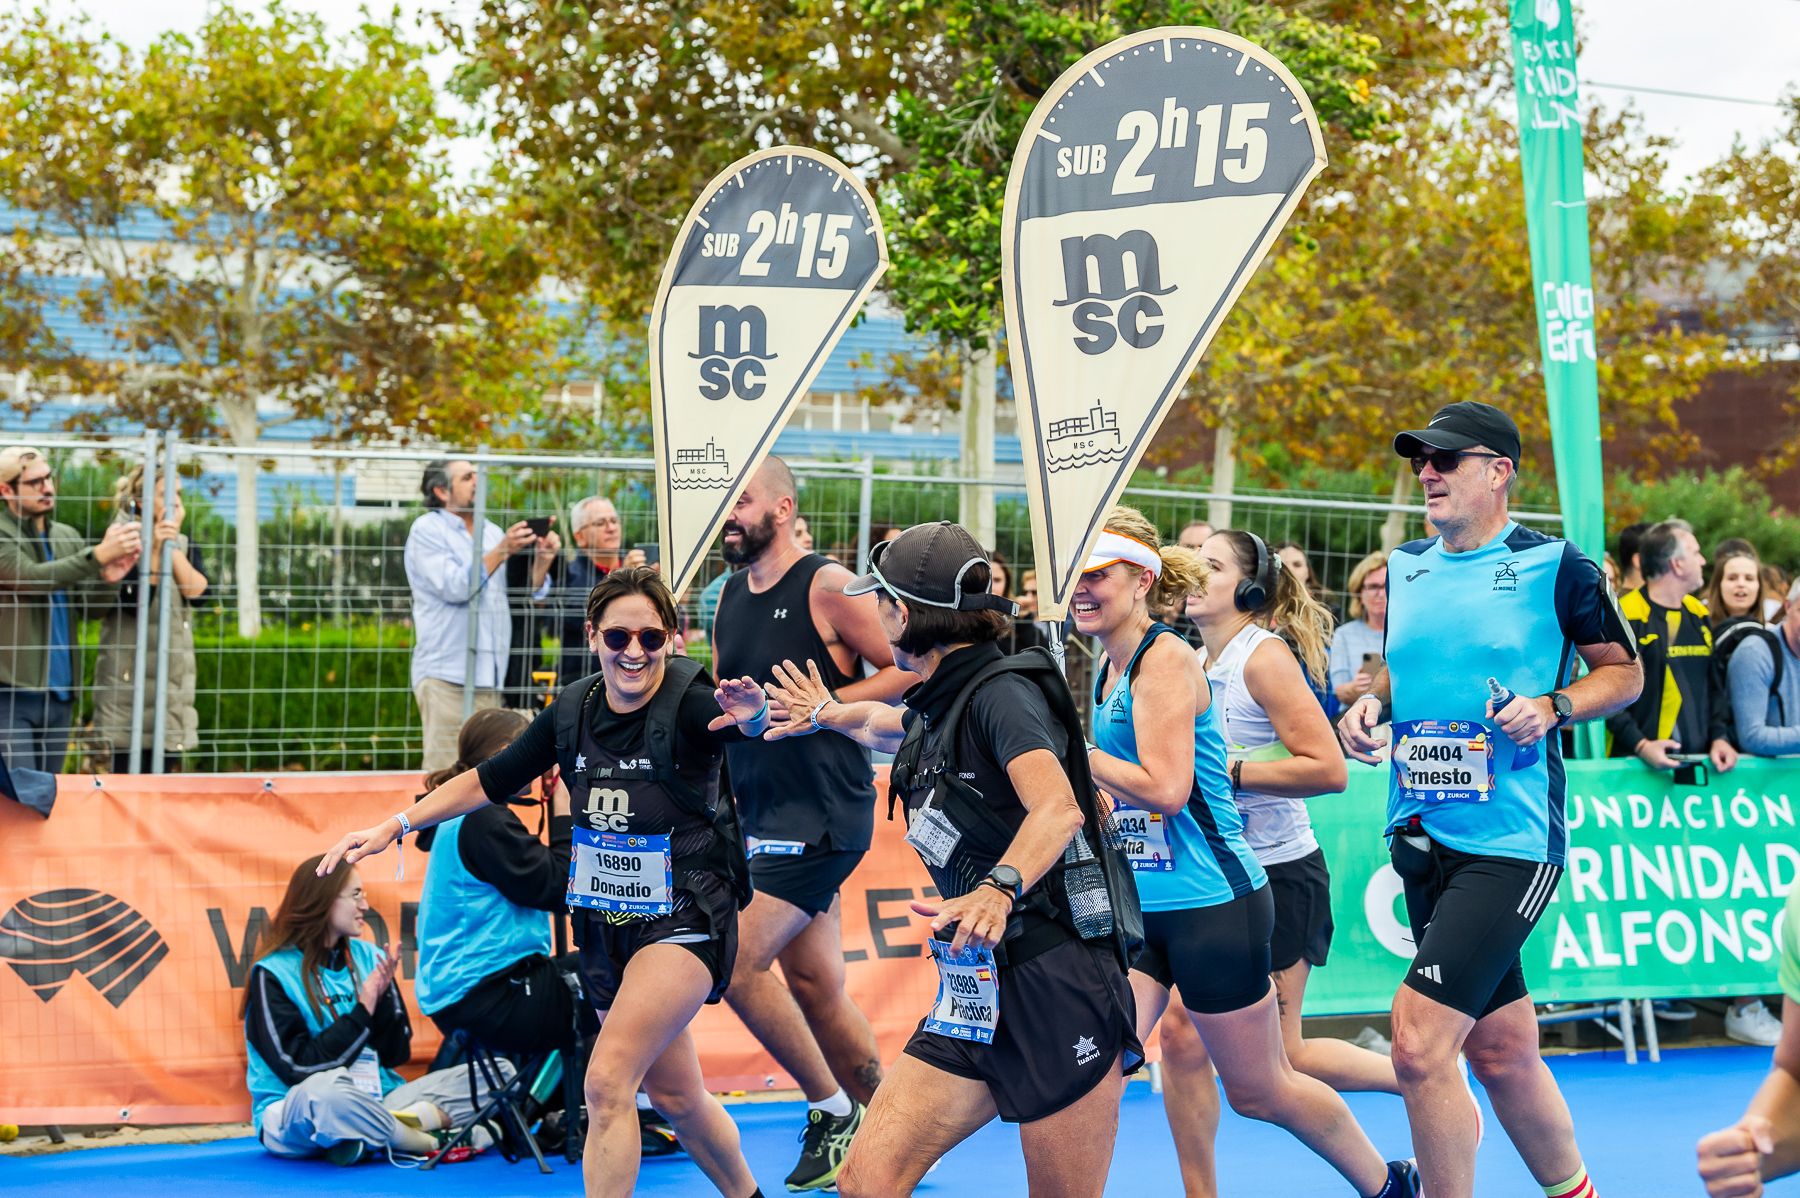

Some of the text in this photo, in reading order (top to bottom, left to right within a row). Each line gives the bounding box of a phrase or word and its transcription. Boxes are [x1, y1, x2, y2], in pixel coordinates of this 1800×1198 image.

[1056, 97, 1270, 196] SUB 2h15
[701, 202, 854, 280] SUB 2h15
[1409, 745, 1463, 761] 20404
[1567, 788, 1796, 830] UNDACIÓN
[595, 852, 642, 872] 16890
[1552, 843, 1800, 902] RINIDAD
[590, 876, 652, 898] Donadío
